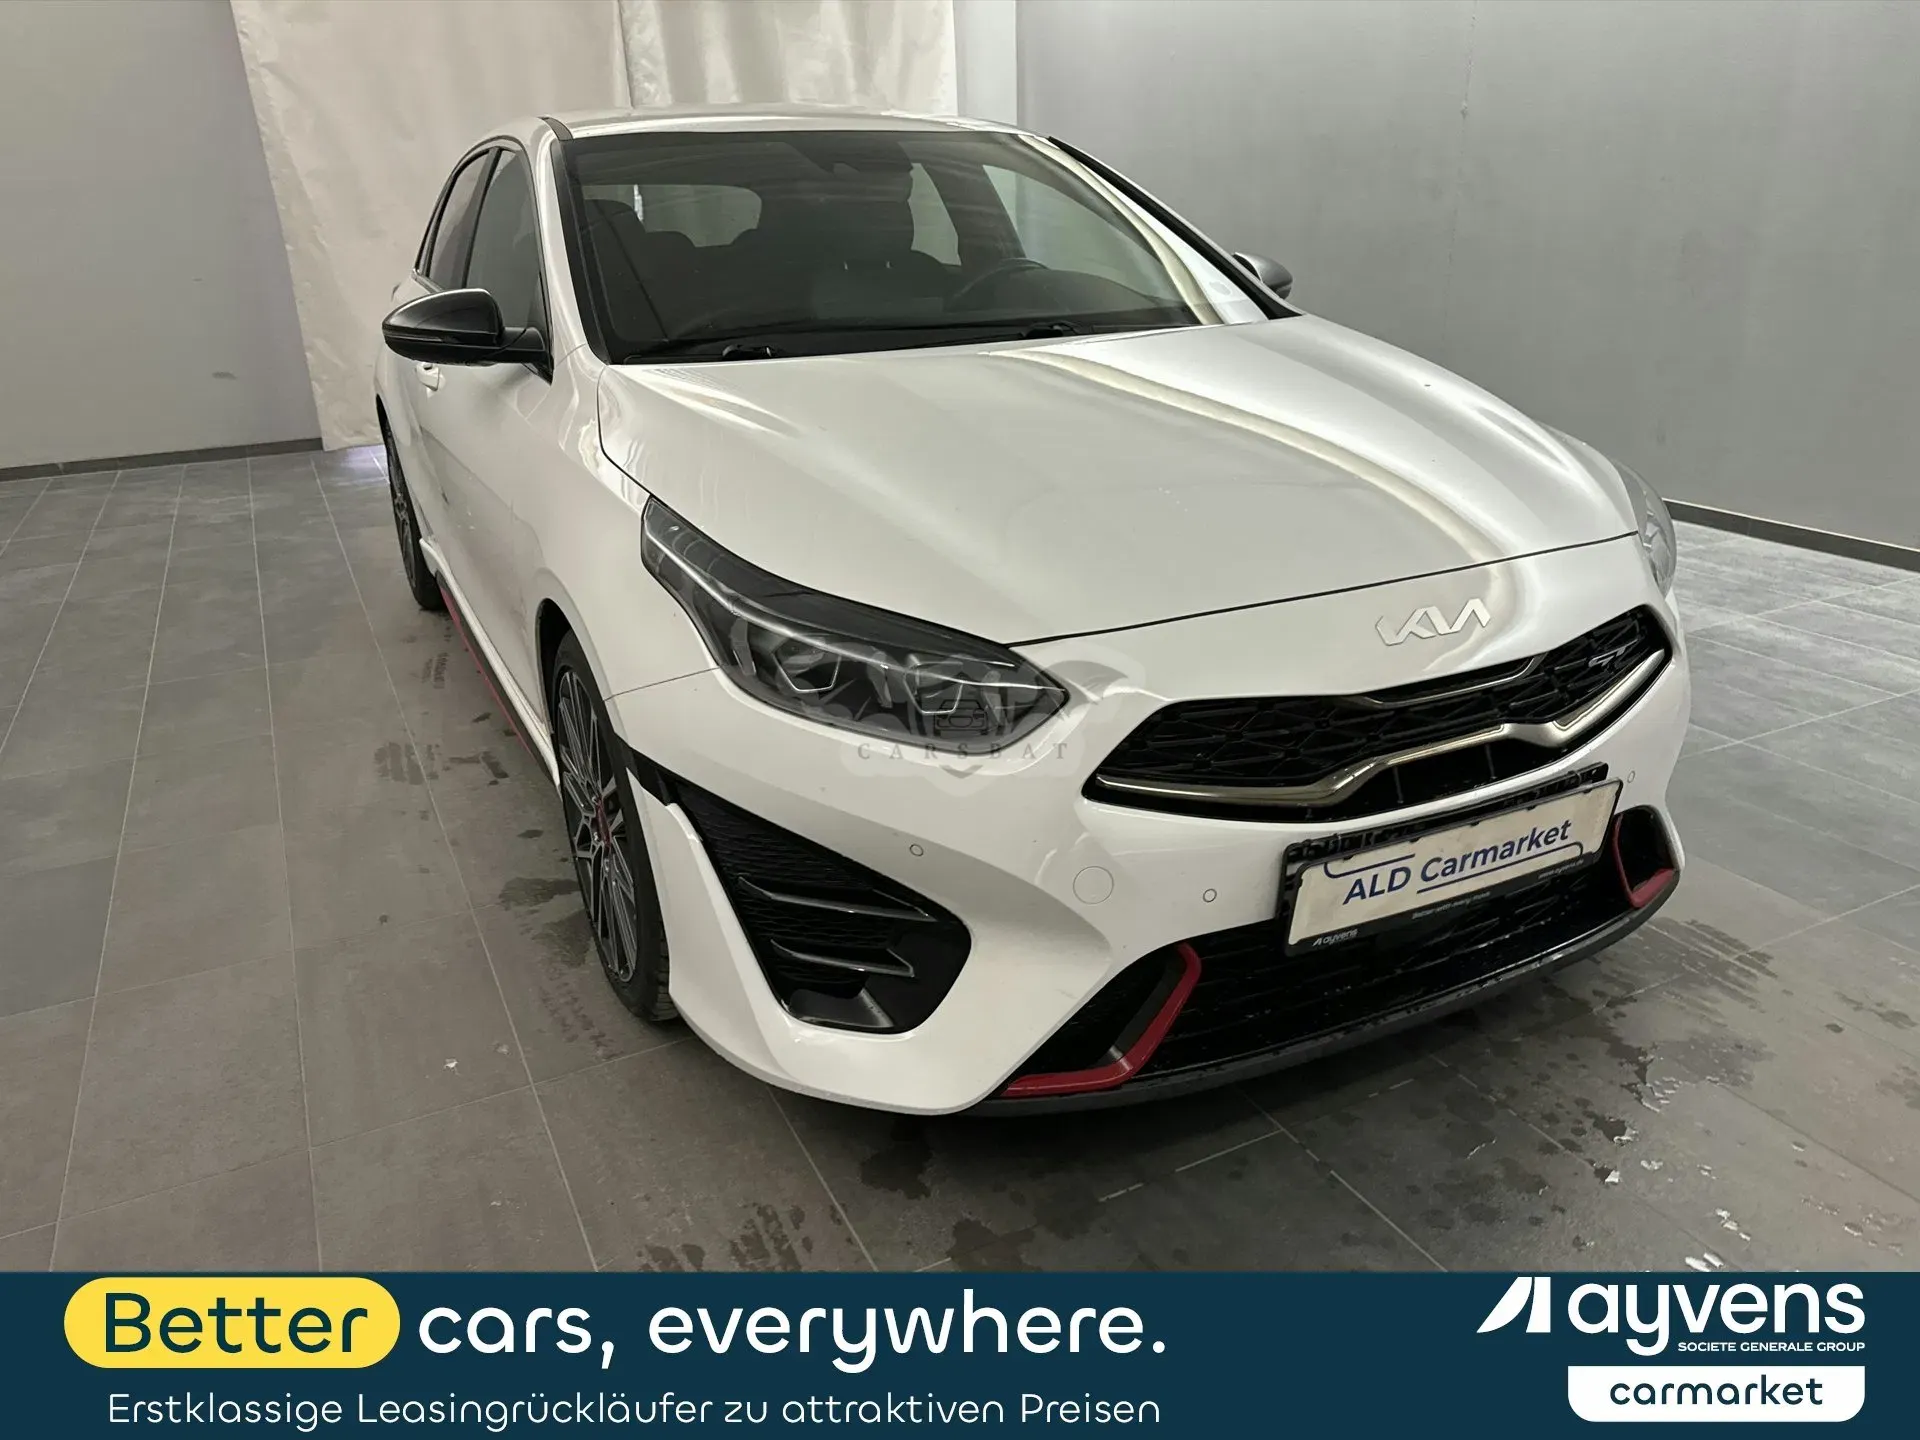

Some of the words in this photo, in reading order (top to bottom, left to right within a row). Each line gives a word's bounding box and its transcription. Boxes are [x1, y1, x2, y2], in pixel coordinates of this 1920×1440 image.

[1375, 597, 1491, 646] KIA
[1342, 865, 1412, 906] ALD
[1420, 819, 1573, 883] Carmarket
